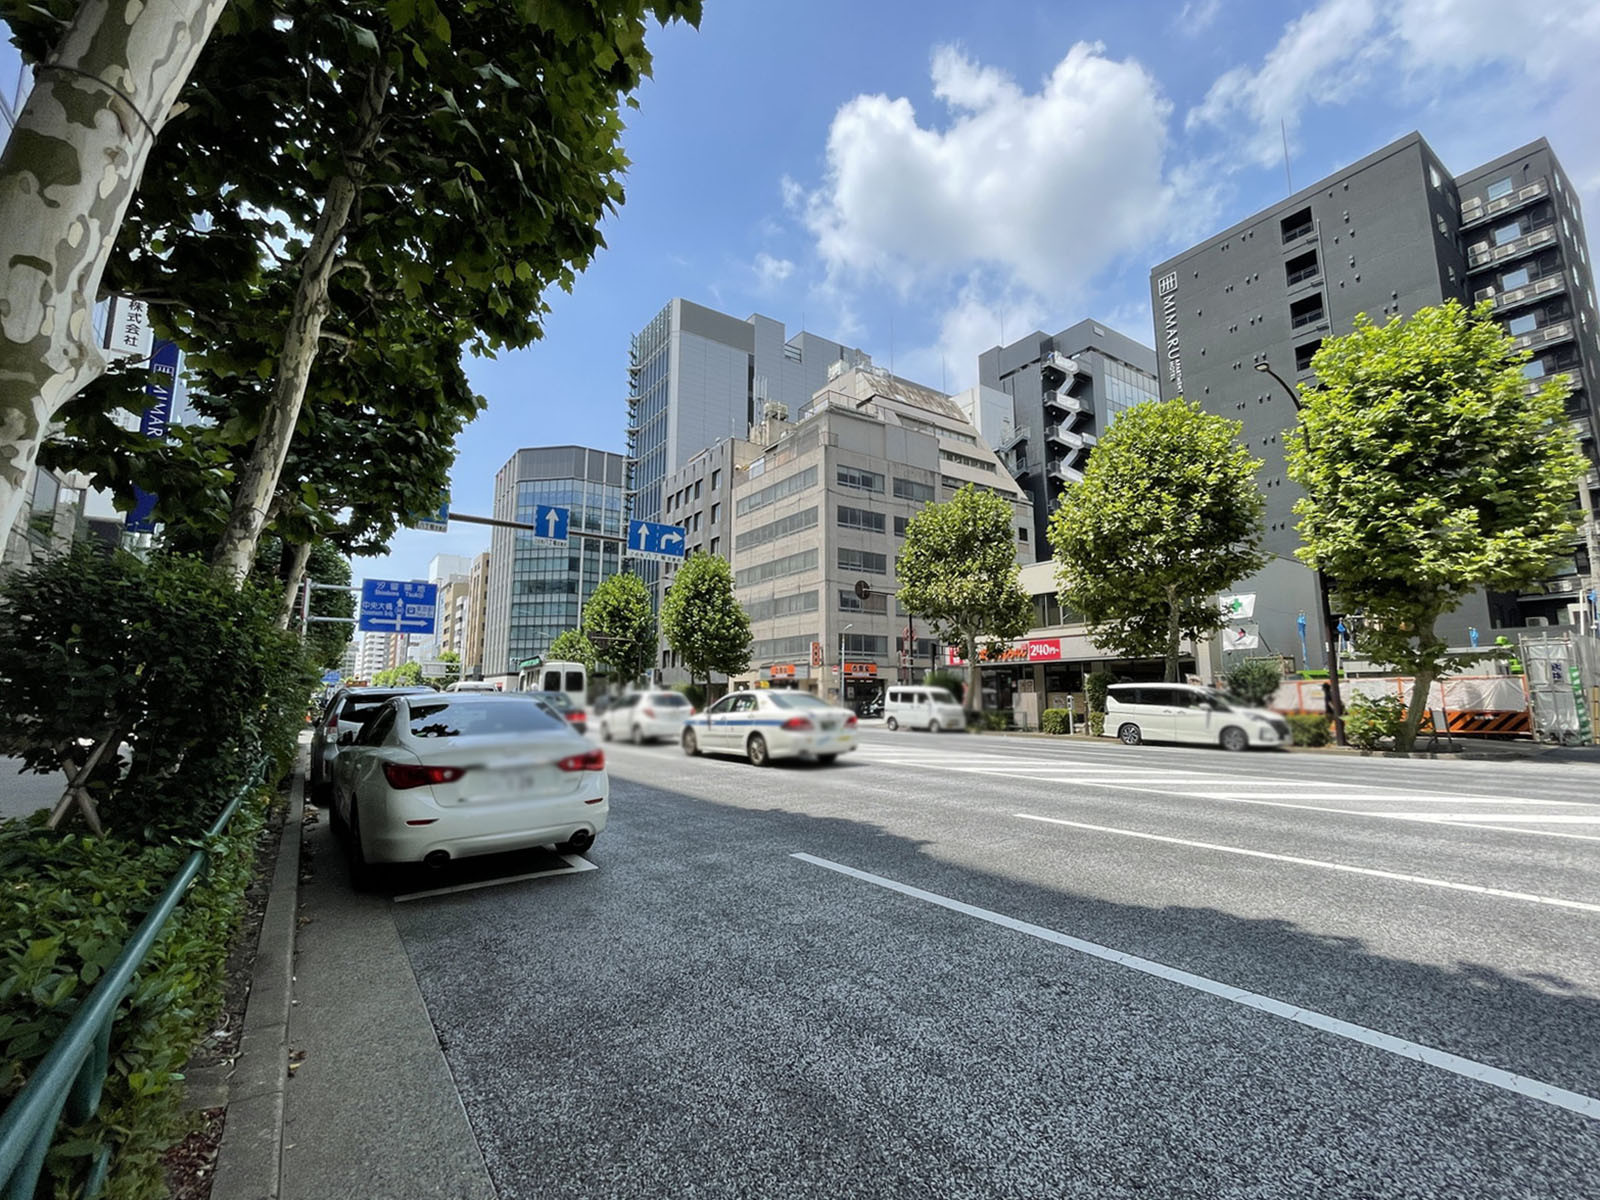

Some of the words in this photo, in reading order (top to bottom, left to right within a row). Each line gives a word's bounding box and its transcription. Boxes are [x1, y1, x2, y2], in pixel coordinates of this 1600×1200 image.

[123, 299, 143, 347] 株式会社
[1163, 294, 1179, 360] MIMARU
